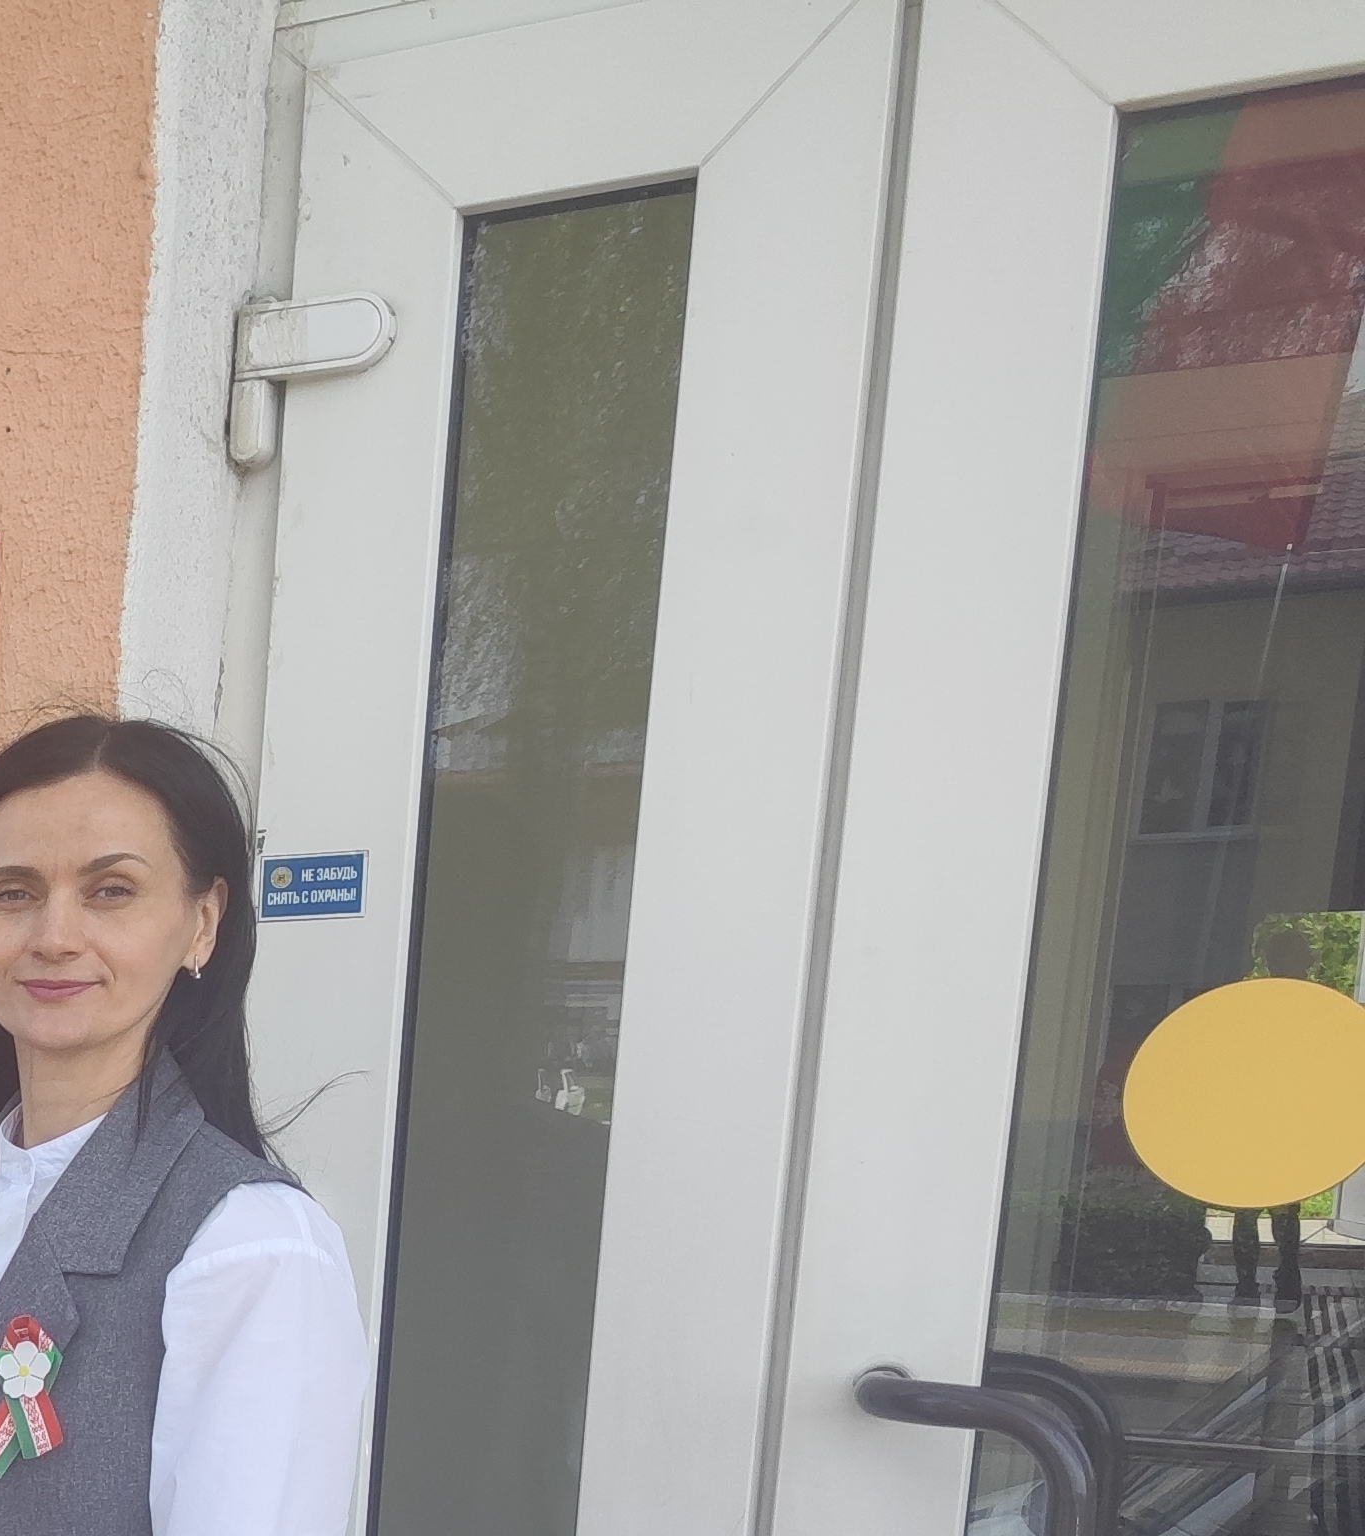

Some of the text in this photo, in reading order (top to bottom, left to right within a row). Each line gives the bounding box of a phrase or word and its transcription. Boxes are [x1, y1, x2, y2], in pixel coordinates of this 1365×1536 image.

[301, 866, 357, 882] НЕ ЗАБУДЬ
[267, 887, 357, 906] СНЯТЬ С ОХРАНЫ!
